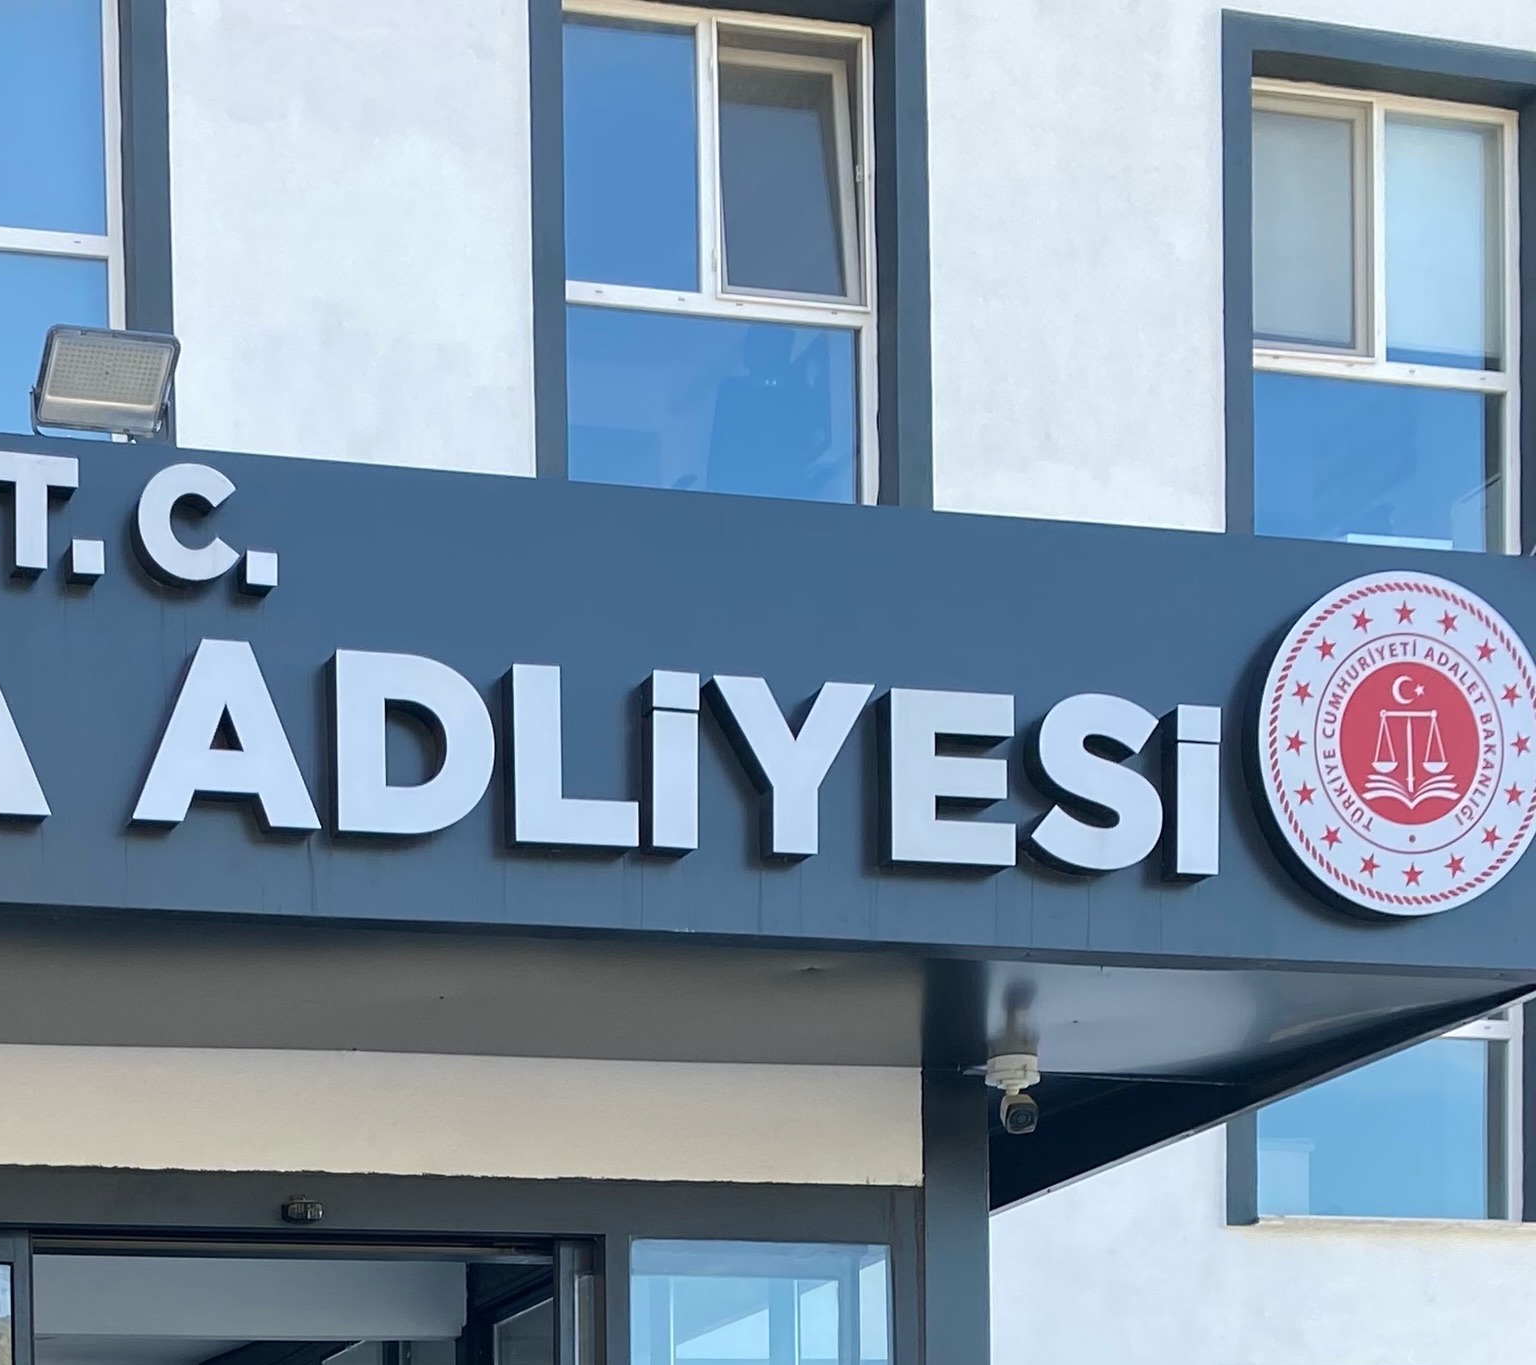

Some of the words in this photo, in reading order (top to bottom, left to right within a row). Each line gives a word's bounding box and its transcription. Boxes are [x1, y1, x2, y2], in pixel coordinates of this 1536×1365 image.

[1322, 638, 1418, 740] CUMHURİYETİ
[1423, 646, 1486, 705] ADALET
[131, 638, 1223, 877] ADLİYESİ
[1323, 748, 1374, 832] TÜRKİYE
[1454, 712, 1497, 826] BAKANLIĞI
